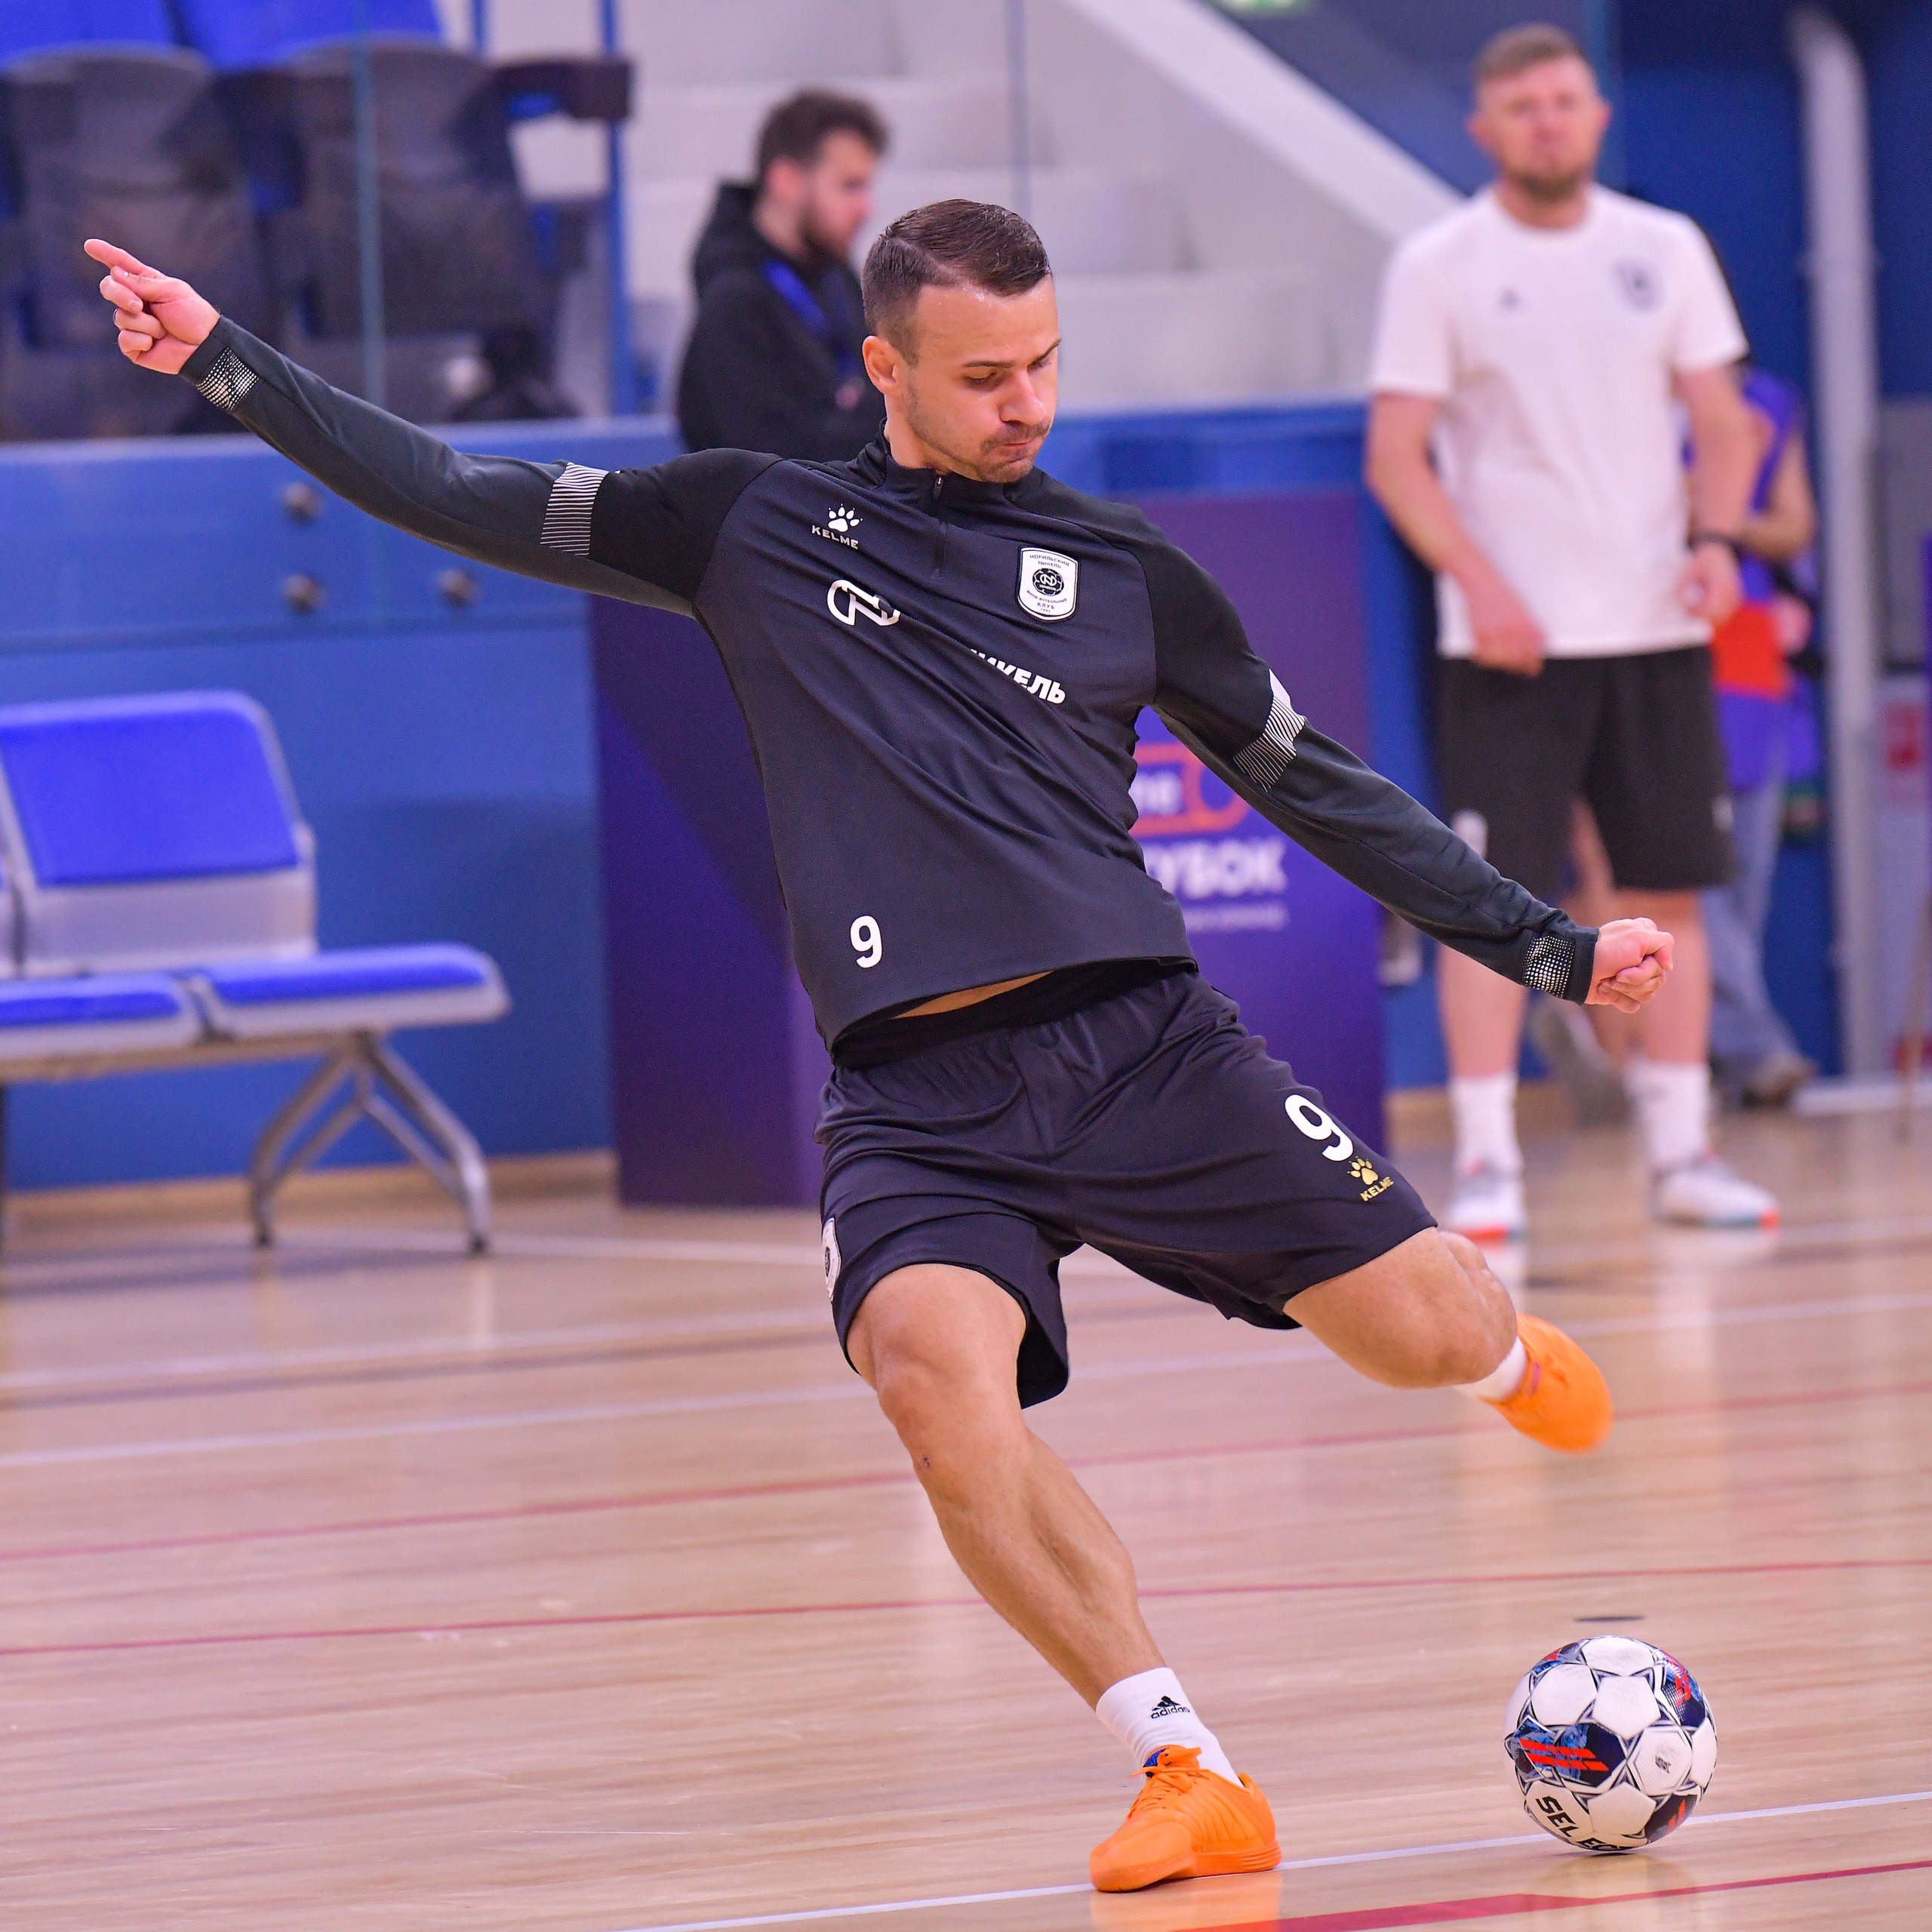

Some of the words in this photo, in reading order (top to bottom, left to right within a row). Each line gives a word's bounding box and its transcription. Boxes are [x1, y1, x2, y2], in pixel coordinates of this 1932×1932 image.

[811, 525, 860, 550] KELME
[970, 648, 1066, 704] КЕЛЬ
[850, 915, 883, 969] 9
[1284, 1094, 1354, 1161] 9
[1359, 1176, 1395, 1202] KELME
[1150, 1704, 1191, 1720] adidas
